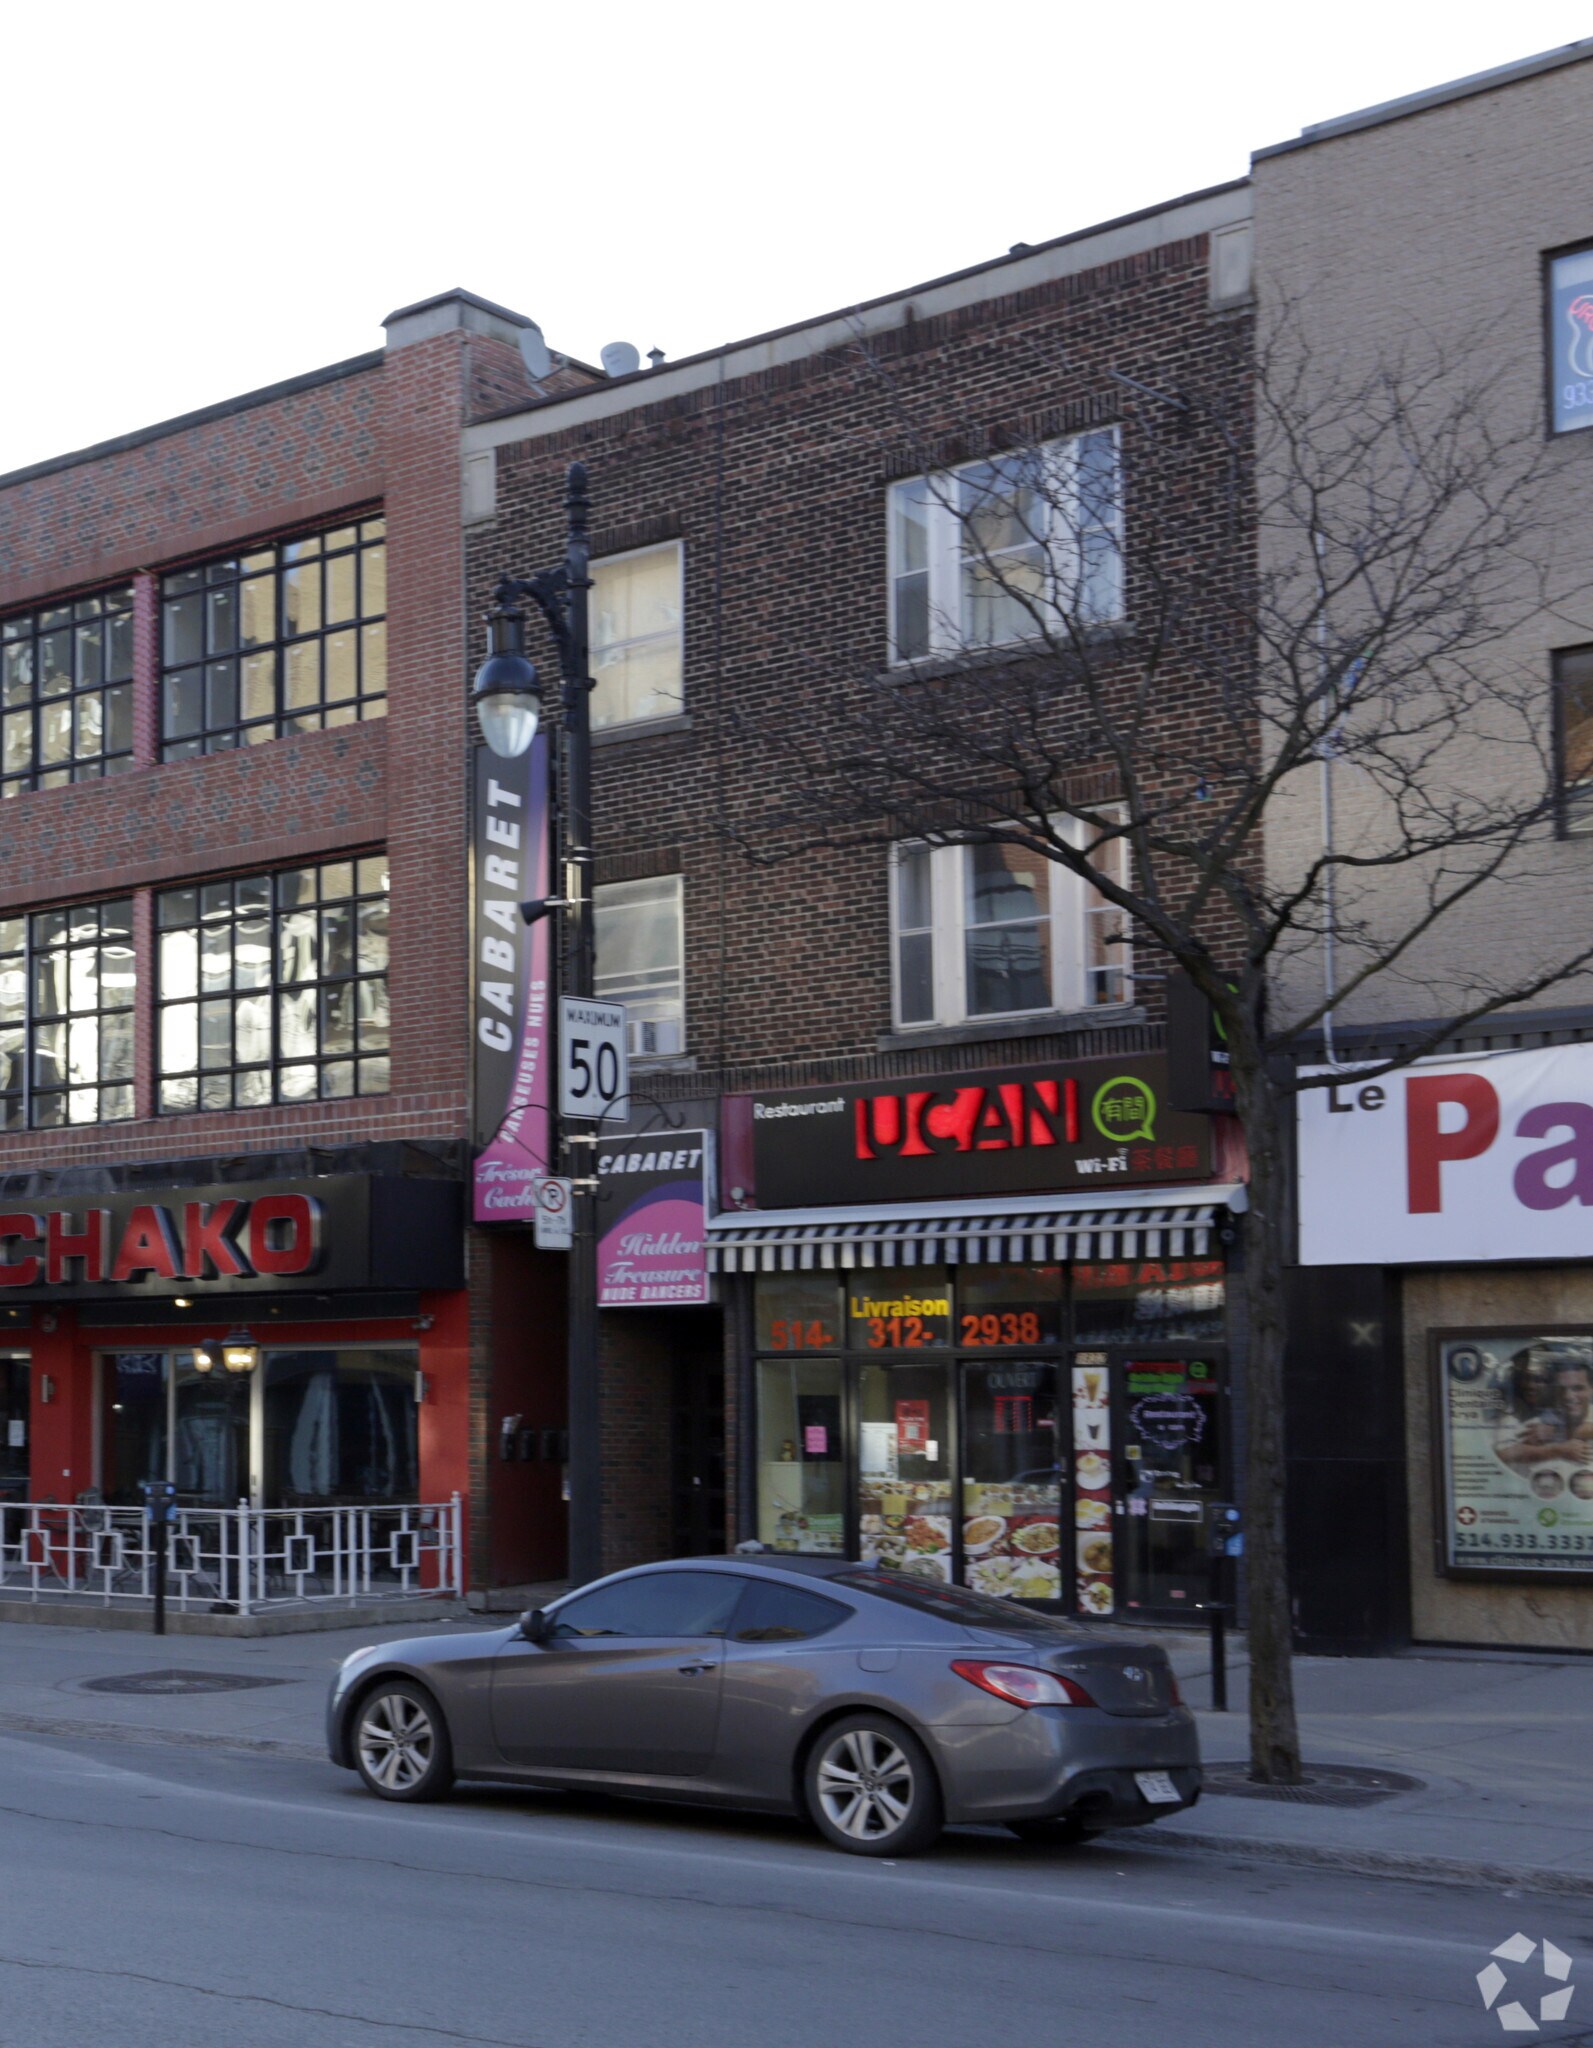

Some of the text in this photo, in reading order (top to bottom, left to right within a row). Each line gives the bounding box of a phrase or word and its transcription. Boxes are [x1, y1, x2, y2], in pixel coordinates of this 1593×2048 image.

[479, 778, 521, 1051] CABARET
[526, 979, 547, 1027] NUES
[569, 1038, 618, 1101] 50
[753, 1097, 846, 1120] Restaurant
[1328, 1084, 1386, 1113] Le
[598, 1149, 702, 1175] CABARET
[1074, 1156, 1128, 1174] Wi-Fi
[617, 1232, 701, 1256] Hidden
[604, 1261, 702, 1285] Treasure
[601, 1284, 703, 1300] NUDE DANCERS
[850, 1296, 949, 1318] Livraison
[770, 1320, 834, 1349] 514-
[867, 1316, 934, 1348] 312-
[961, 1312, 1040, 1346] 2938
